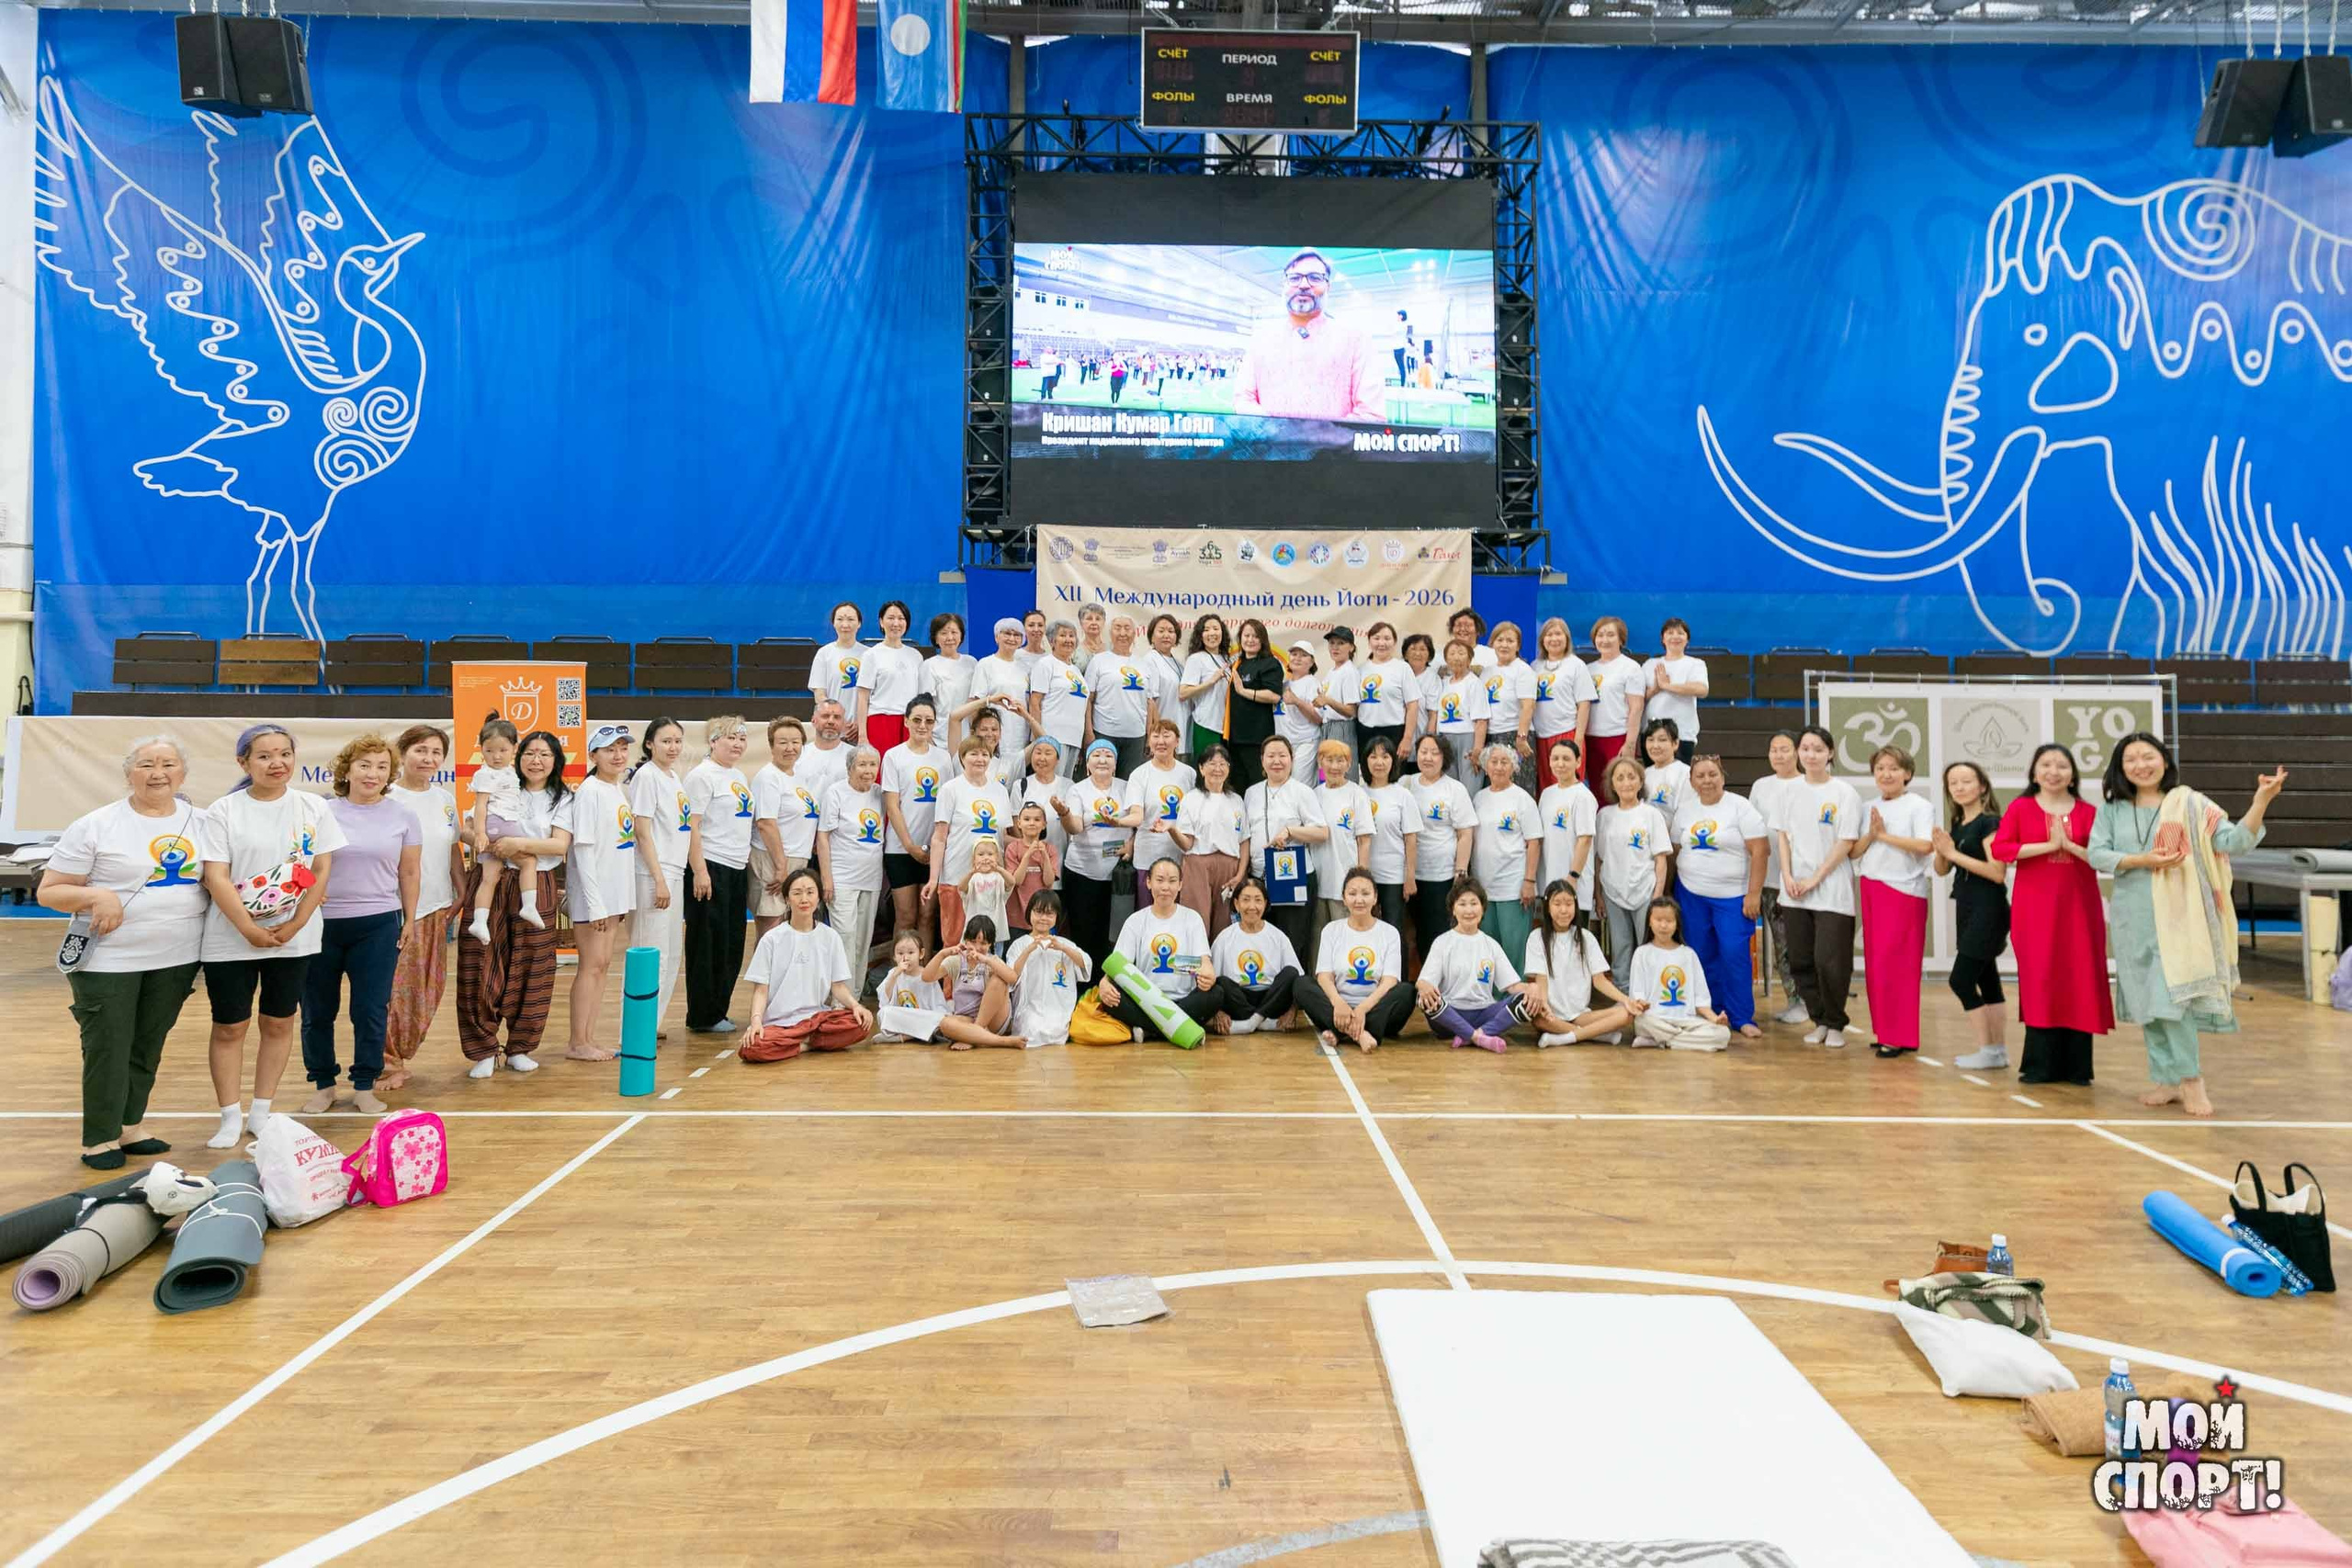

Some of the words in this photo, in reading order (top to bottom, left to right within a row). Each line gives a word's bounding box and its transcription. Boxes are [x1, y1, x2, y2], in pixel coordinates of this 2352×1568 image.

[1158, 47, 1189, 59] СЧЁТ
[1310, 50, 1341, 62] СЧЁТ
[1222, 53, 1278, 66] ПЕРИОД
[1151, 92, 1194, 103] ФОЛЫ
[1226, 93, 1272, 104] ВРЕМЯ
[1304, 95, 1347, 106] ФОЛЫ
[1042, 412, 1113, 434] Кришан
[1115, 412, 1170, 434] Кумар
[1173, 414, 1214, 434] Гоял
[1041, 435, 1088, 446] Президент
[1353, 428, 1395, 451] МОЙ
[1396, 434, 1461, 453] СПОРТ!
[1055, 585, 1081, 602] XII
[1095, 587, 1274, 610] Международный
[1280, 593, 1330, 611] день
[1337, 588, 1387, 607] Йоги
[1404, 589, 1454, 606] 2026
[2068, 706, 2136, 739] YO
